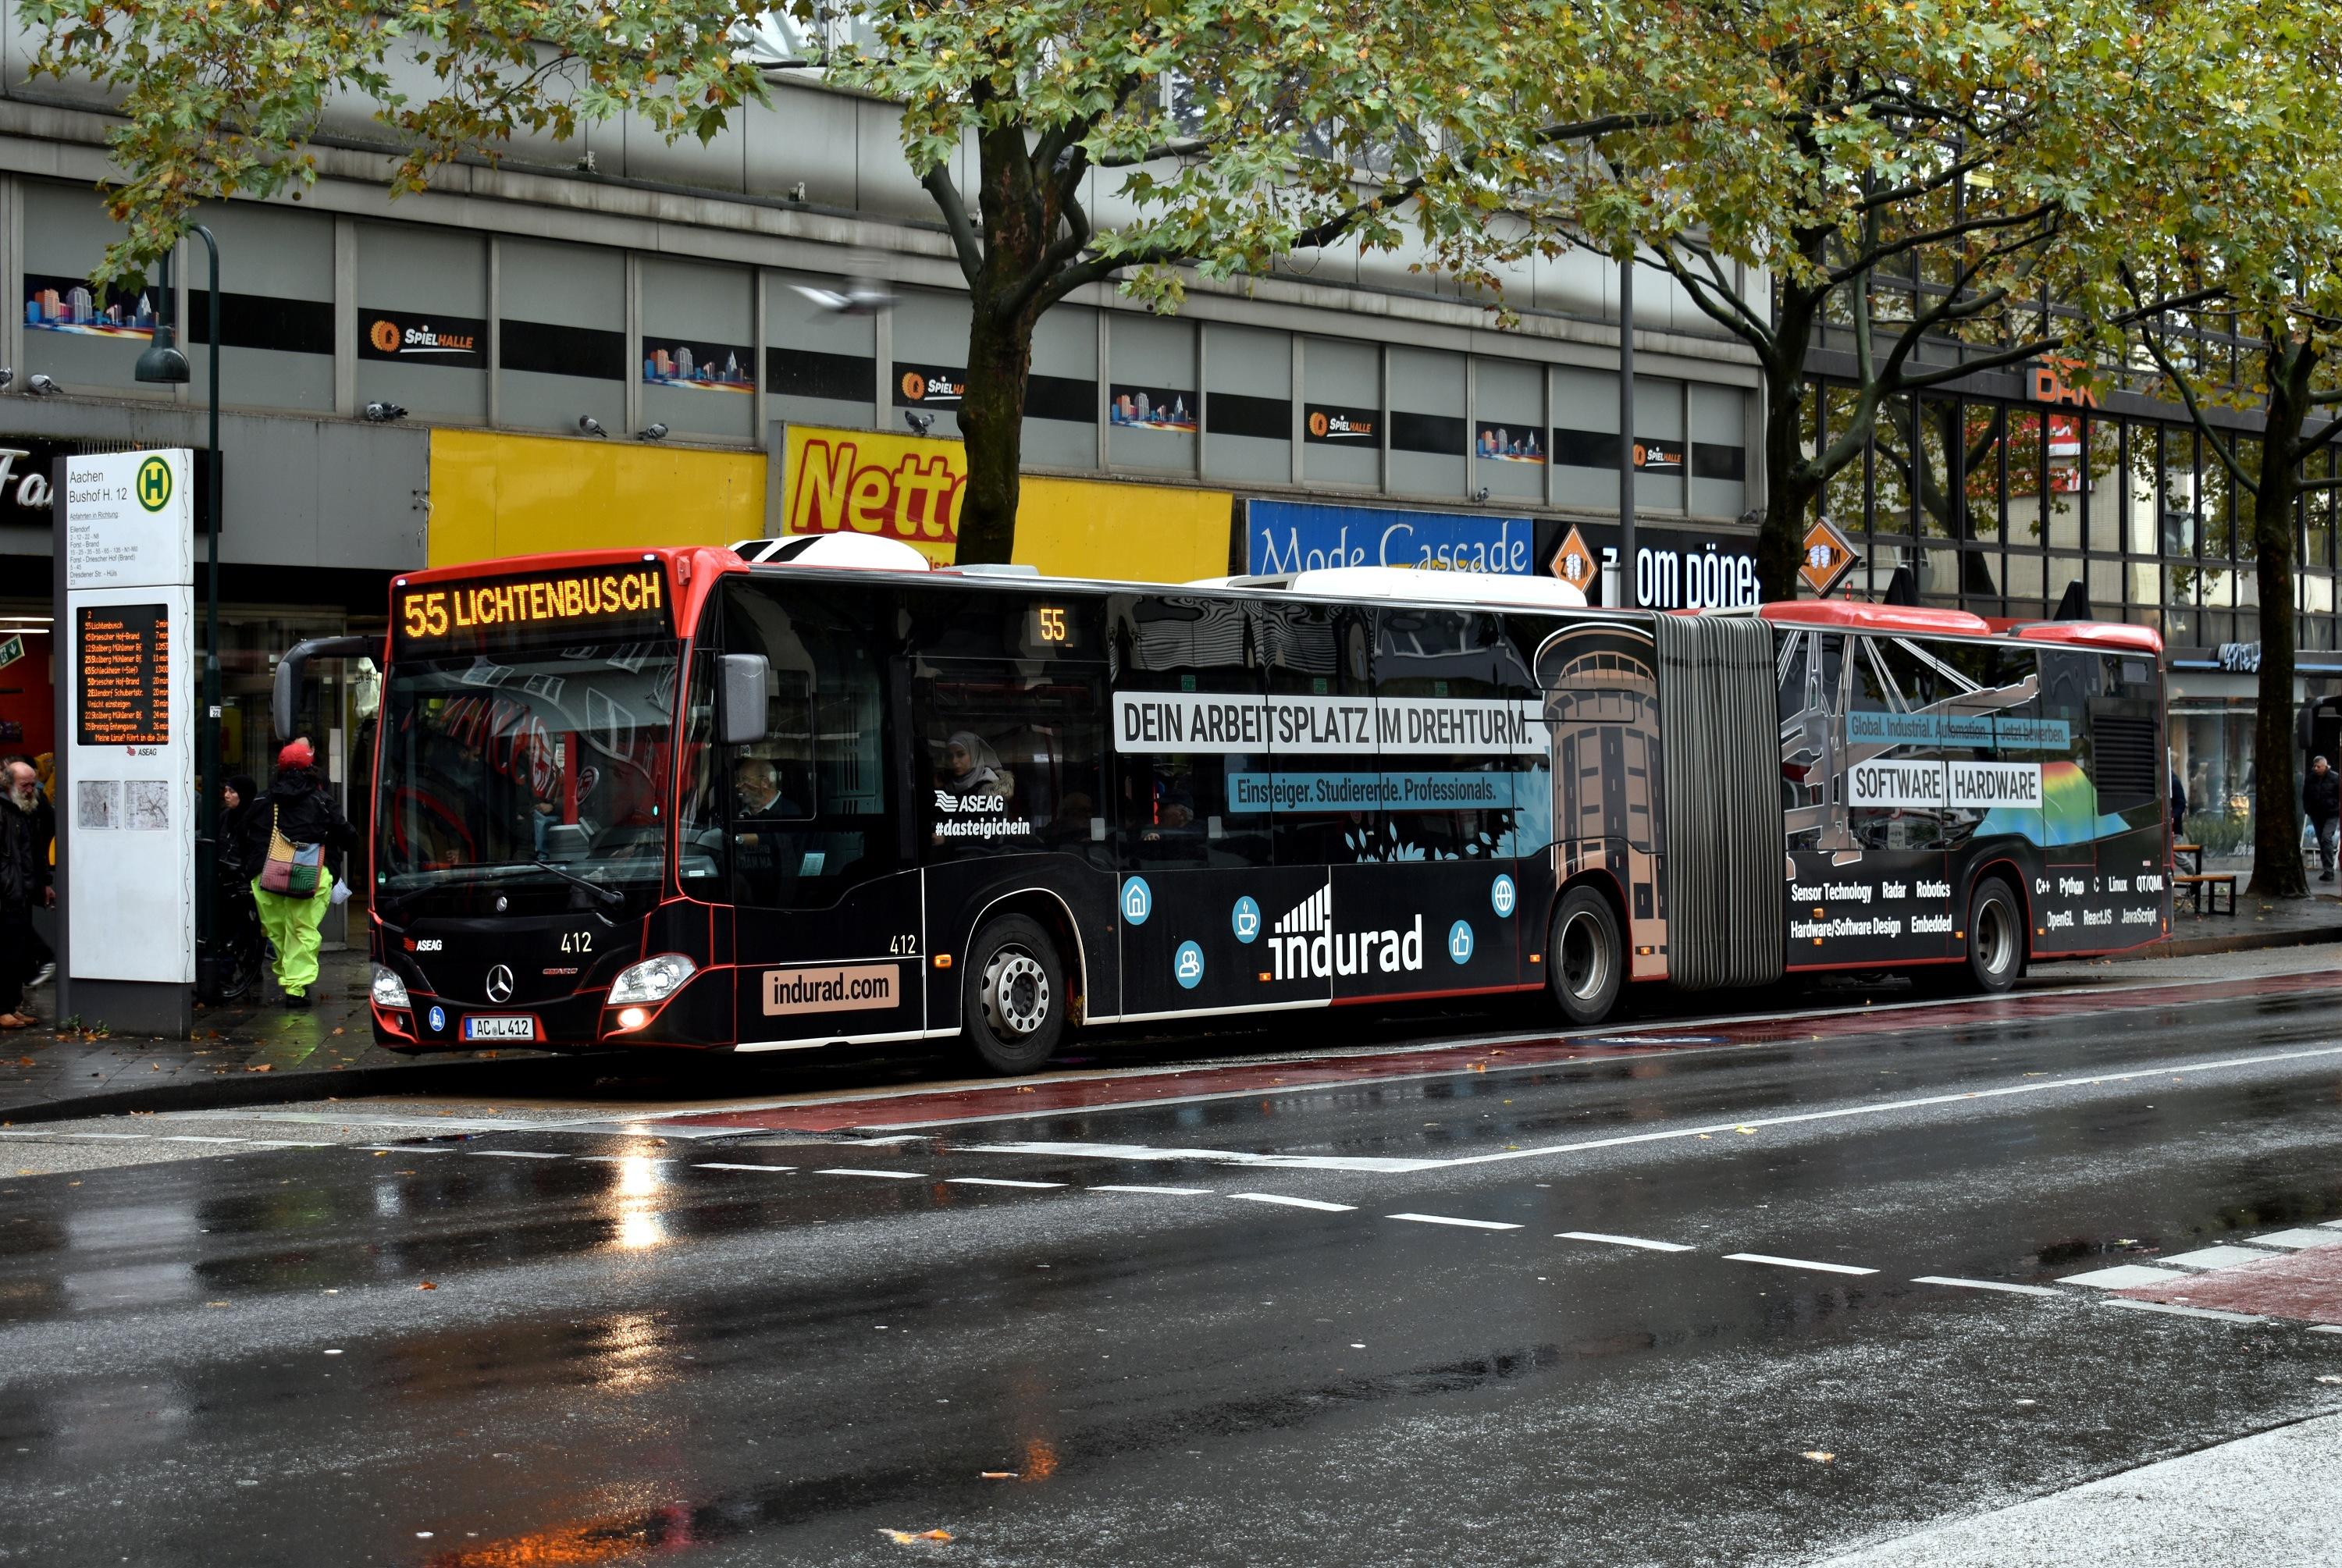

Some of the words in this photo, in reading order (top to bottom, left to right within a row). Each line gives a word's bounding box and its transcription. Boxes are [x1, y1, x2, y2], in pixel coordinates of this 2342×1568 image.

[404, 325, 474, 349] SPIELHALLE
[1329, 414, 1372, 433] SPIELHALLE
[1647, 446, 1682, 463] SPIELHALLE
[0, 448, 53, 510] Fa
[70, 471, 103, 484] Aachen
[146, 468, 163, 500] H
[69, 489, 100, 503] Bushof
[103, 489, 113, 501] H.
[116, 487, 127, 500] 12
[1261, 526, 1365, 575] Mode
[1379, 521, 1528, 574] Cascade
[404, 593, 449, 638] 55
[454, 571, 661, 627] LICHTENBUSCH
[91, 621, 123, 630] Lichtenbusch
[1041, 609, 1065, 641] 55
[91, 689, 112, 698] Eilendorf
[1124, 702, 1183, 742] DEIN
[1191, 704, 1369, 744] ARBEITSPLATZ
[1376, 708, 1402, 744] IM
[1408, 708, 1532, 745] DREHTURM.
[1852, 715, 1885, 737] Global.
[1887, 717, 1932, 738] Industrial.
[1934, 720, 1988, 740] Automation.
[2002, 723, 2022, 741] Jetzt
[2023, 723, 2066, 743] bewerben.
[1238, 778, 1312, 810] Einsteiger.
[1316, 777, 1402, 803] Studierende.
[1405, 777, 1497, 802] Professionals.
[1856, 767, 1942, 798] SOFTWARE
[1955, 770, 2037, 800] HARDWARE
[959, 795, 1004, 812] ASEAG
[935, 817, 1030, 840] #dasteigichein
[1791, 883, 1822, 901] Sensor
[1823, 881, 1872, 904] Technology
[1882, 880, 1906, 898] Radar
[1916, 880, 1951, 898] Robotics
[2036, 878, 2051, 894] C++
[2059, 876, 2084, 898] Python
[2093, 876, 2100, 892] C
[2109, 876, 2127, 892] Linux
[2136, 875, 2163, 893] QT/QML
[1791, 917, 1872, 938] Hardware/Software
[1873, 916, 1901, 938] Design
[1911, 914, 1952, 933] Embedded
[2047, 910, 2074, 931] OpenGL
[2083, 908, 2112, 926] ReactJS
[2121, 907, 2156, 926] JavaScript
[416, 939, 443, 951] ASEAG
[561, 931, 593, 954] 412
[890, 935, 917, 955] 412
[1268, 890, 1422, 980] indurad
[774, 972, 889, 1005] indurad.com
[477, 1020, 490, 1036] AC
[498, 1020, 505, 1035] L
[508, 1019, 529, 1035] 412
